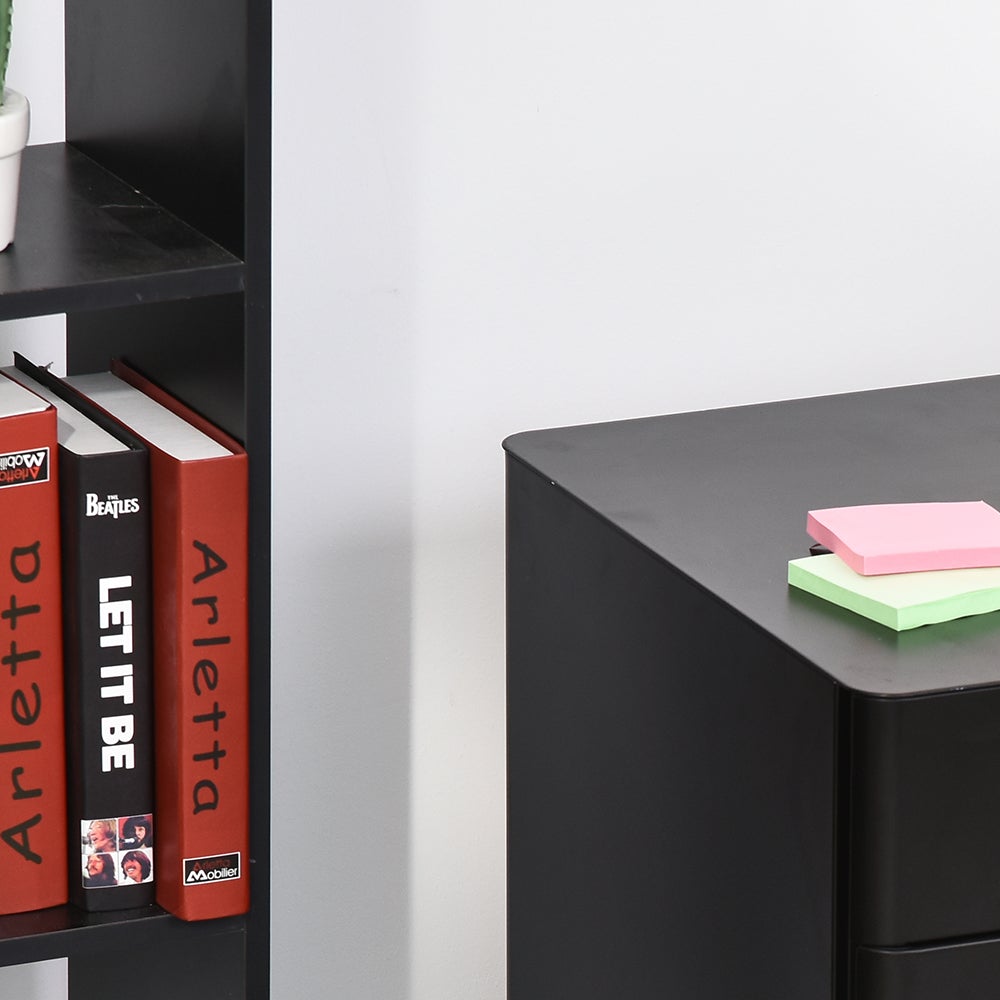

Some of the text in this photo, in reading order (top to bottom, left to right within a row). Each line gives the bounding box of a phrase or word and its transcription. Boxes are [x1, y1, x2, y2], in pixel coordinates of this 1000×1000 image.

[0, 541, 43, 864] Arletta
[98, 575, 135, 773] LET IT BE
[192, 540, 231, 815] Arletta
[186, 867, 238, 882] Mobilier
